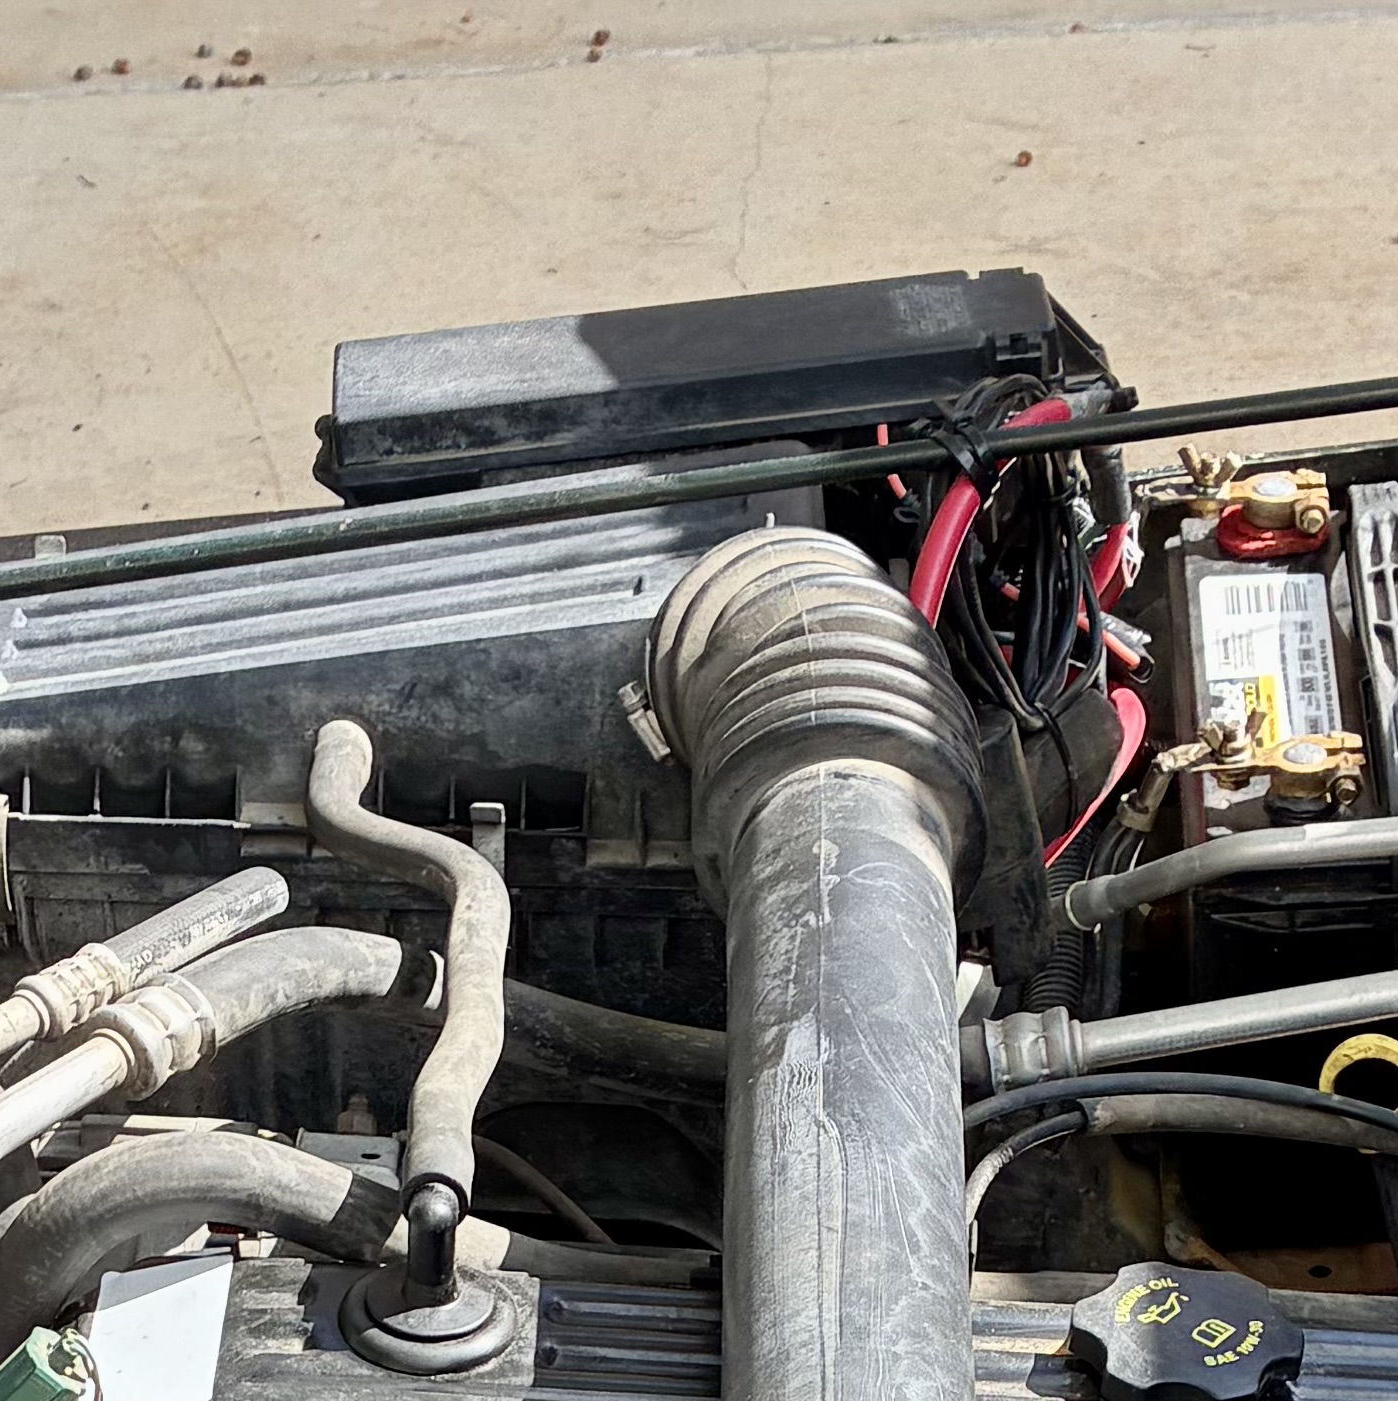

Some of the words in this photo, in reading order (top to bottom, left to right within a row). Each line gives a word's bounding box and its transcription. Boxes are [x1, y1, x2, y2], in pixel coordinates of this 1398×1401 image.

[1114, 1283, 1151, 1323] ENGINE
[1149, 1277, 1179, 1290] OIL
[1204, 1350, 1240, 1367] SAE
